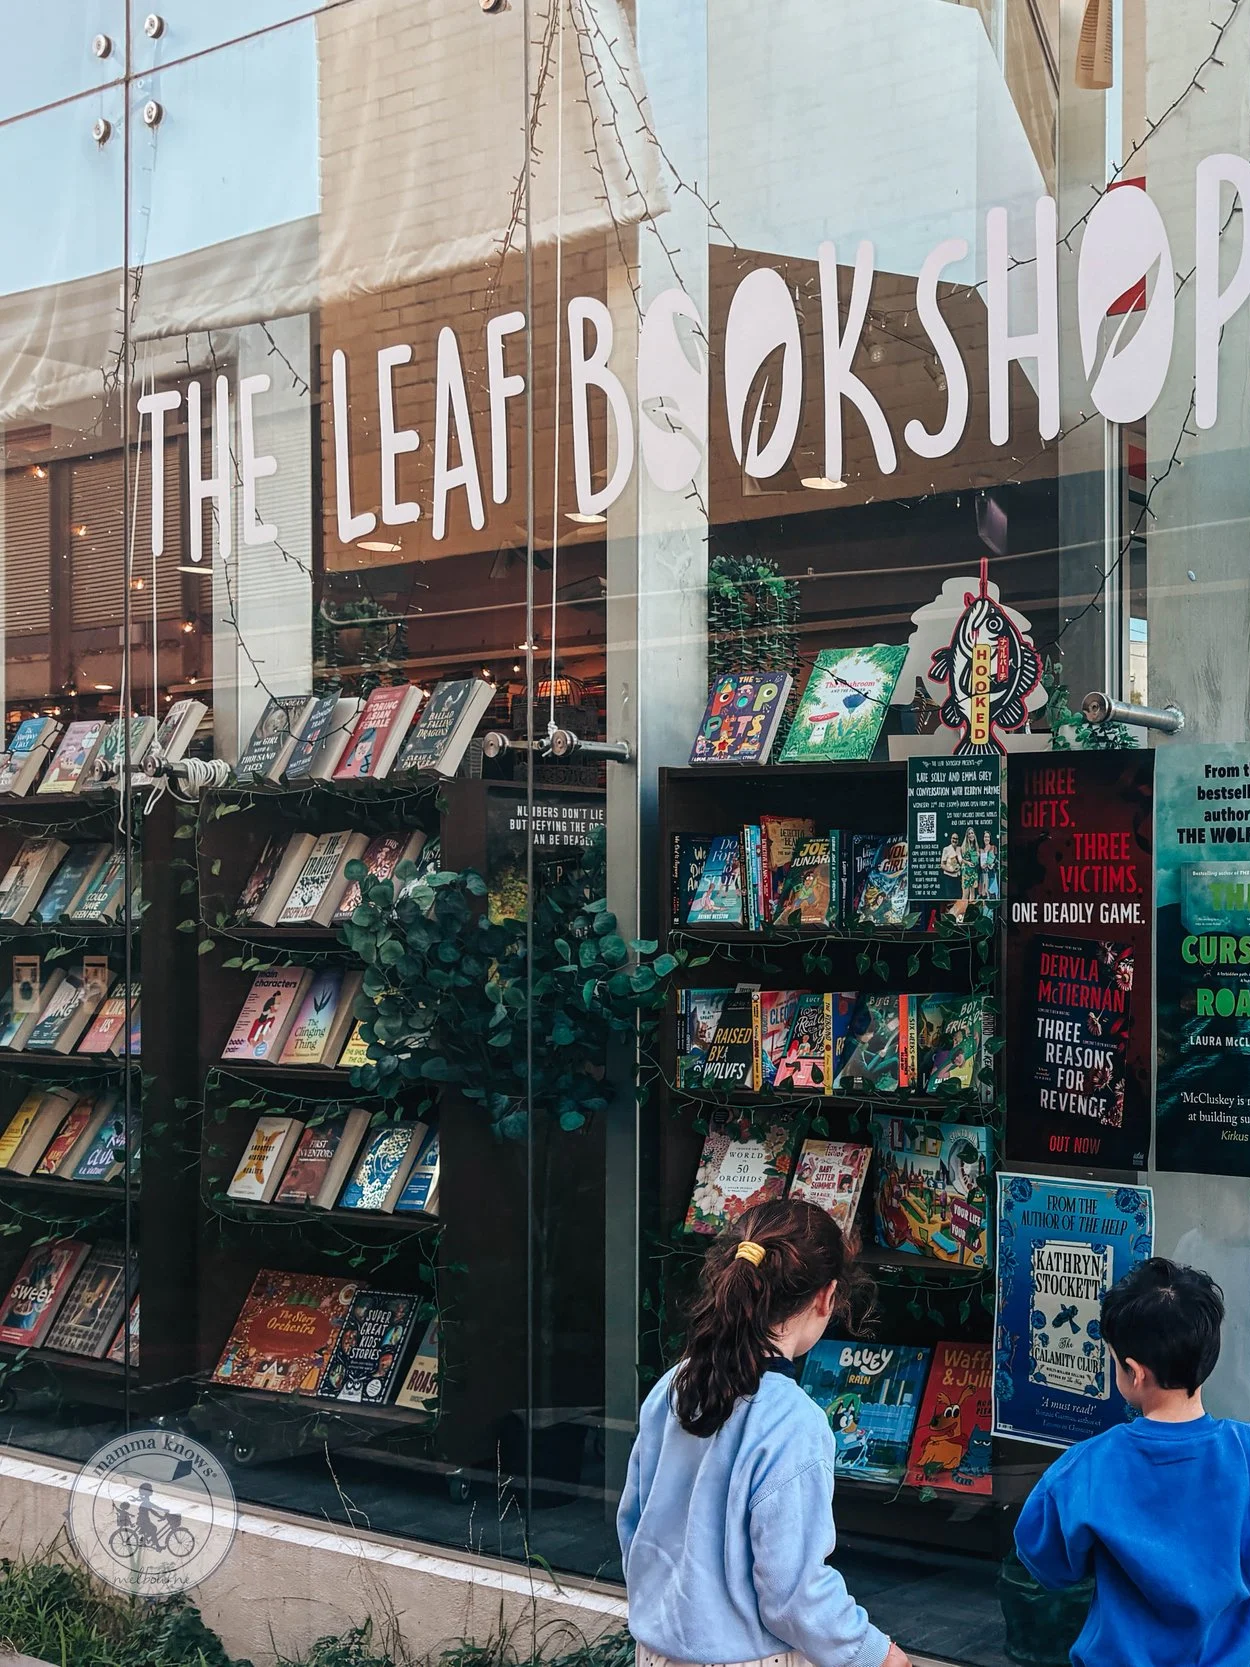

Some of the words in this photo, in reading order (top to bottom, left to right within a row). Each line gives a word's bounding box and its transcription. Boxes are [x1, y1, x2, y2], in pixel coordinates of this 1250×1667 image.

[138, 373, 278, 563] THE
[331, 311, 527, 543] LEAF
[711, 684, 778, 715] POP
[974, 650, 987, 740] HOOKED
[368, 701, 398, 712] BORING
[366, 711, 391, 720] ASIAN
[428, 711, 454, 720] BALLAD
[311, 719, 326, 729] TRAIN
[359, 719, 391, 729] FEMALE
[426, 718, 453, 729] FALLING
[703, 714, 765, 739] PETS
[262, 736, 278, 744] GIRL
[416, 727, 449, 738] DRAGONS
[241, 752, 275, 763] THOUSAND
[243, 763, 263, 772] FACES
[1205, 765, 1239, 778] From
[916, 773, 928, 782] KATE
[931, 772, 946, 782] SOLLY
[949, 772, 960, 781] AND
[962, 771, 976, 781] EMMA
[979, 772, 992, 781] GREY
[1025, 768, 1076, 796] THREE
[916, 787, 950, 796] CONVERSATION
[952, 787, 963, 795] WITH
[562, 808, 587, 819] DON'T
[591, 809, 604, 820] LIE
[1020, 800, 1076, 828] GIFTS.
[1204, 806, 1250, 822] author
[510, 819, 528, 830] BUT
[571, 822, 585, 832] THE
[549, 835, 560, 845] BE
[1177, 828, 1206, 844] THE
[1074, 833, 1130, 861] THREE
[1060, 865, 1144, 893] VICTIMS.
[86, 893, 108, 901] COULD
[82, 901, 101, 909] HAVE
[1012, 903, 1037, 923] ONE
[1044, 903, 1094, 924] DEADLY
[1100, 903, 1146, 925] GAME.
[1040, 953, 1099, 982] DERVLA
[254, 979, 297, 988] characters
[106, 1000, 125, 1015] LIKE
[99, 1019, 114, 1032] US
[295, 1027, 326, 1038] Clinging
[1037, 1018, 1081, 1042] THREE
[714, 1028, 752, 1043] RAISED
[1190, 1036, 1222, 1047] LAURA
[295, 1039, 317, 1050] Thing
[708, 1046, 723, 1062] BY
[1046, 1043, 1114, 1070] REASONS
[703, 1062, 746, 1079] WOLVES
[1057, 1068, 1084, 1091] FOR
[1040, 1088, 1107, 1119] REVENGE
[1237, 1094, 1244, 1106] is
[1188, 1113, 1196, 1122] at
[1200, 1111, 1238, 1127] building
[1221, 1130, 1249, 1142] Kirkus
[310, 1139, 328, 1149] FIRST
[1049, 1135, 1070, 1152] OUT
[1074, 1137, 1100, 1155] NOW
[736, 1165, 749, 1173] 50
[719, 1175, 763, 1183] ORCHIDS
[811, 1182, 836, 1190] SUMMER
[1047, 1195, 1076, 1212] FROM
[1079, 1198, 1098, 1215] THE
[954, 1205, 968, 1218] YOUR
[970, 1212, 981, 1226] LIFE
[1021, 1211, 1059, 1231] AUTHOR
[1061, 1216, 1075, 1231] OF
[1079, 1218, 1100, 1233] THE
[1101, 1220, 1128, 1236] HELP
[951, 1225, 966, 1240] YOUR
[1037, 1250, 1101, 1277] KATHRYN
[11, 1285, 55, 1303] sweet
[1035, 1273, 1100, 1300] STOCKETT
[279, 1310, 293, 1321] The
[292, 1311, 317, 1326] Story
[366, 1309, 391, 1324] SUPER
[267, 1319, 316, 1335] Orchestra
[360, 1324, 388, 1336] GREAT
[350, 1348, 382, 1360] STORIES
[839, 1347, 894, 1375] BLUEY
[1034, 1348, 1077, 1370] CALAMITY
[1077, 1356, 1099, 1373] CLUB
[848, 1374, 870, 1385] RAIN
[1051, 1401, 1070, 1410] must
